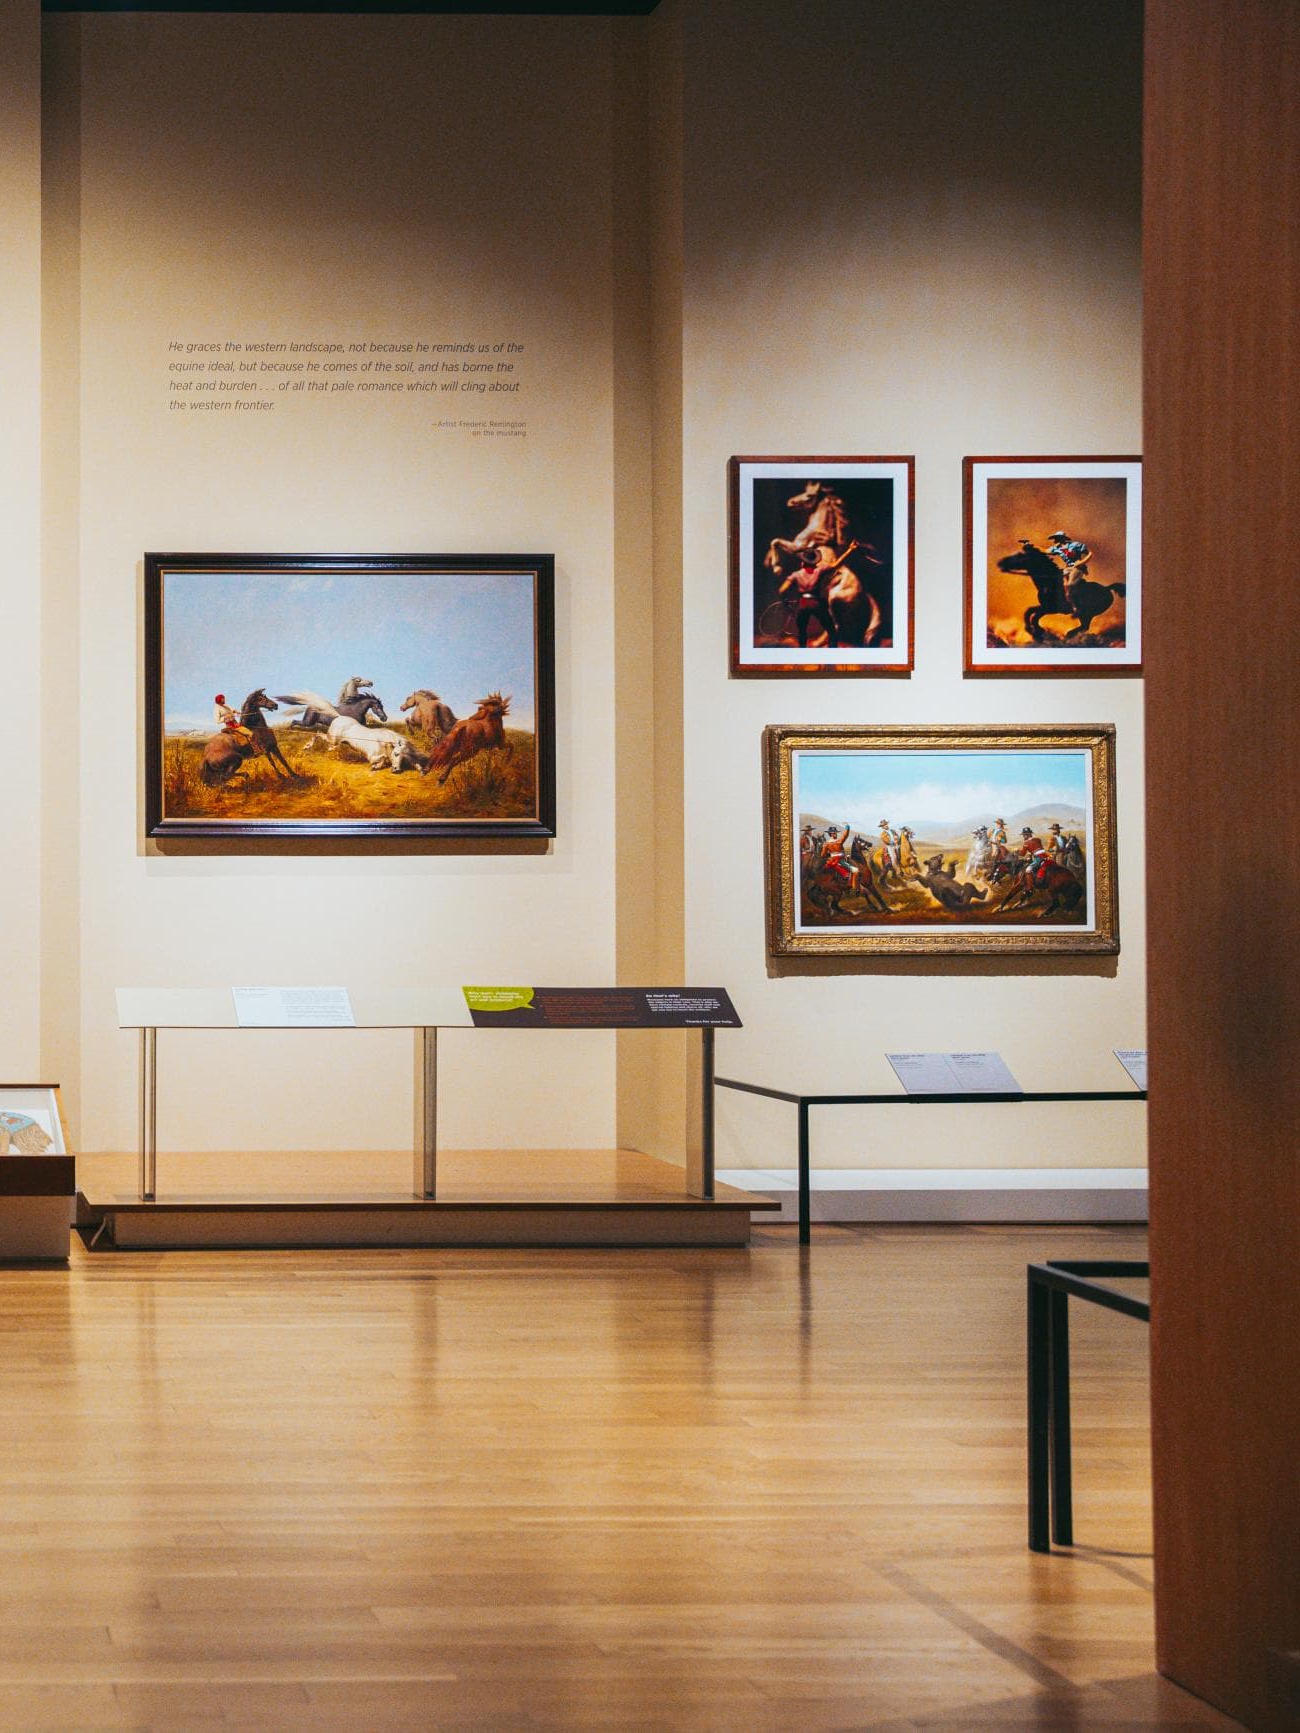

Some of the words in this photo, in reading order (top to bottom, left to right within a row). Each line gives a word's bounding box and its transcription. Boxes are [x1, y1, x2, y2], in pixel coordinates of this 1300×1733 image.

[169, 341, 184, 352] He
[186, 343, 222, 354] graces
[224, 341, 241, 352] the
[245, 342, 287, 352] western
[289, 342, 345, 354] landscape,
[348, 343, 367, 353] not
[369, 342, 413, 353] because
[416, 342, 429, 353] he
[432, 342, 475, 353] reminds
[478, 344, 490, 353] us
[493, 342, 505, 353] of
[507, 342, 524, 353] the
[168, 361, 205, 373] equine
[208, 361, 235, 373] ideal,
[239, 361, 257, 372] but
[260, 361, 304, 372] because
[306, 361, 320, 372] he
[323, 363, 358, 372] comes
[360, 361, 373, 372] of
[375, 361, 392, 372] the
[394, 361, 415, 373] soil,
[418, 361, 439, 372] and
[441, 361, 460, 372] has
[463, 361, 494, 372] borne
[496, 362, 514, 373] the
[169, 380, 193, 391] heat
[195, 380, 217, 391] and
[219, 380, 257, 391] burden
[278, 381, 290, 391] of
[292, 380, 305, 391] all
[308, 381, 328, 391] that
[331, 381, 355, 393] pale
[357, 382, 404, 391] romance
[407, 381, 437, 392] which
[441, 381, 459, 392] will
[461, 381, 486, 394] cling
[489, 381, 520, 392] about
[169, 399, 187, 410] the
[190, 400, 231, 410] western
[234, 399, 275, 411] frontier.
